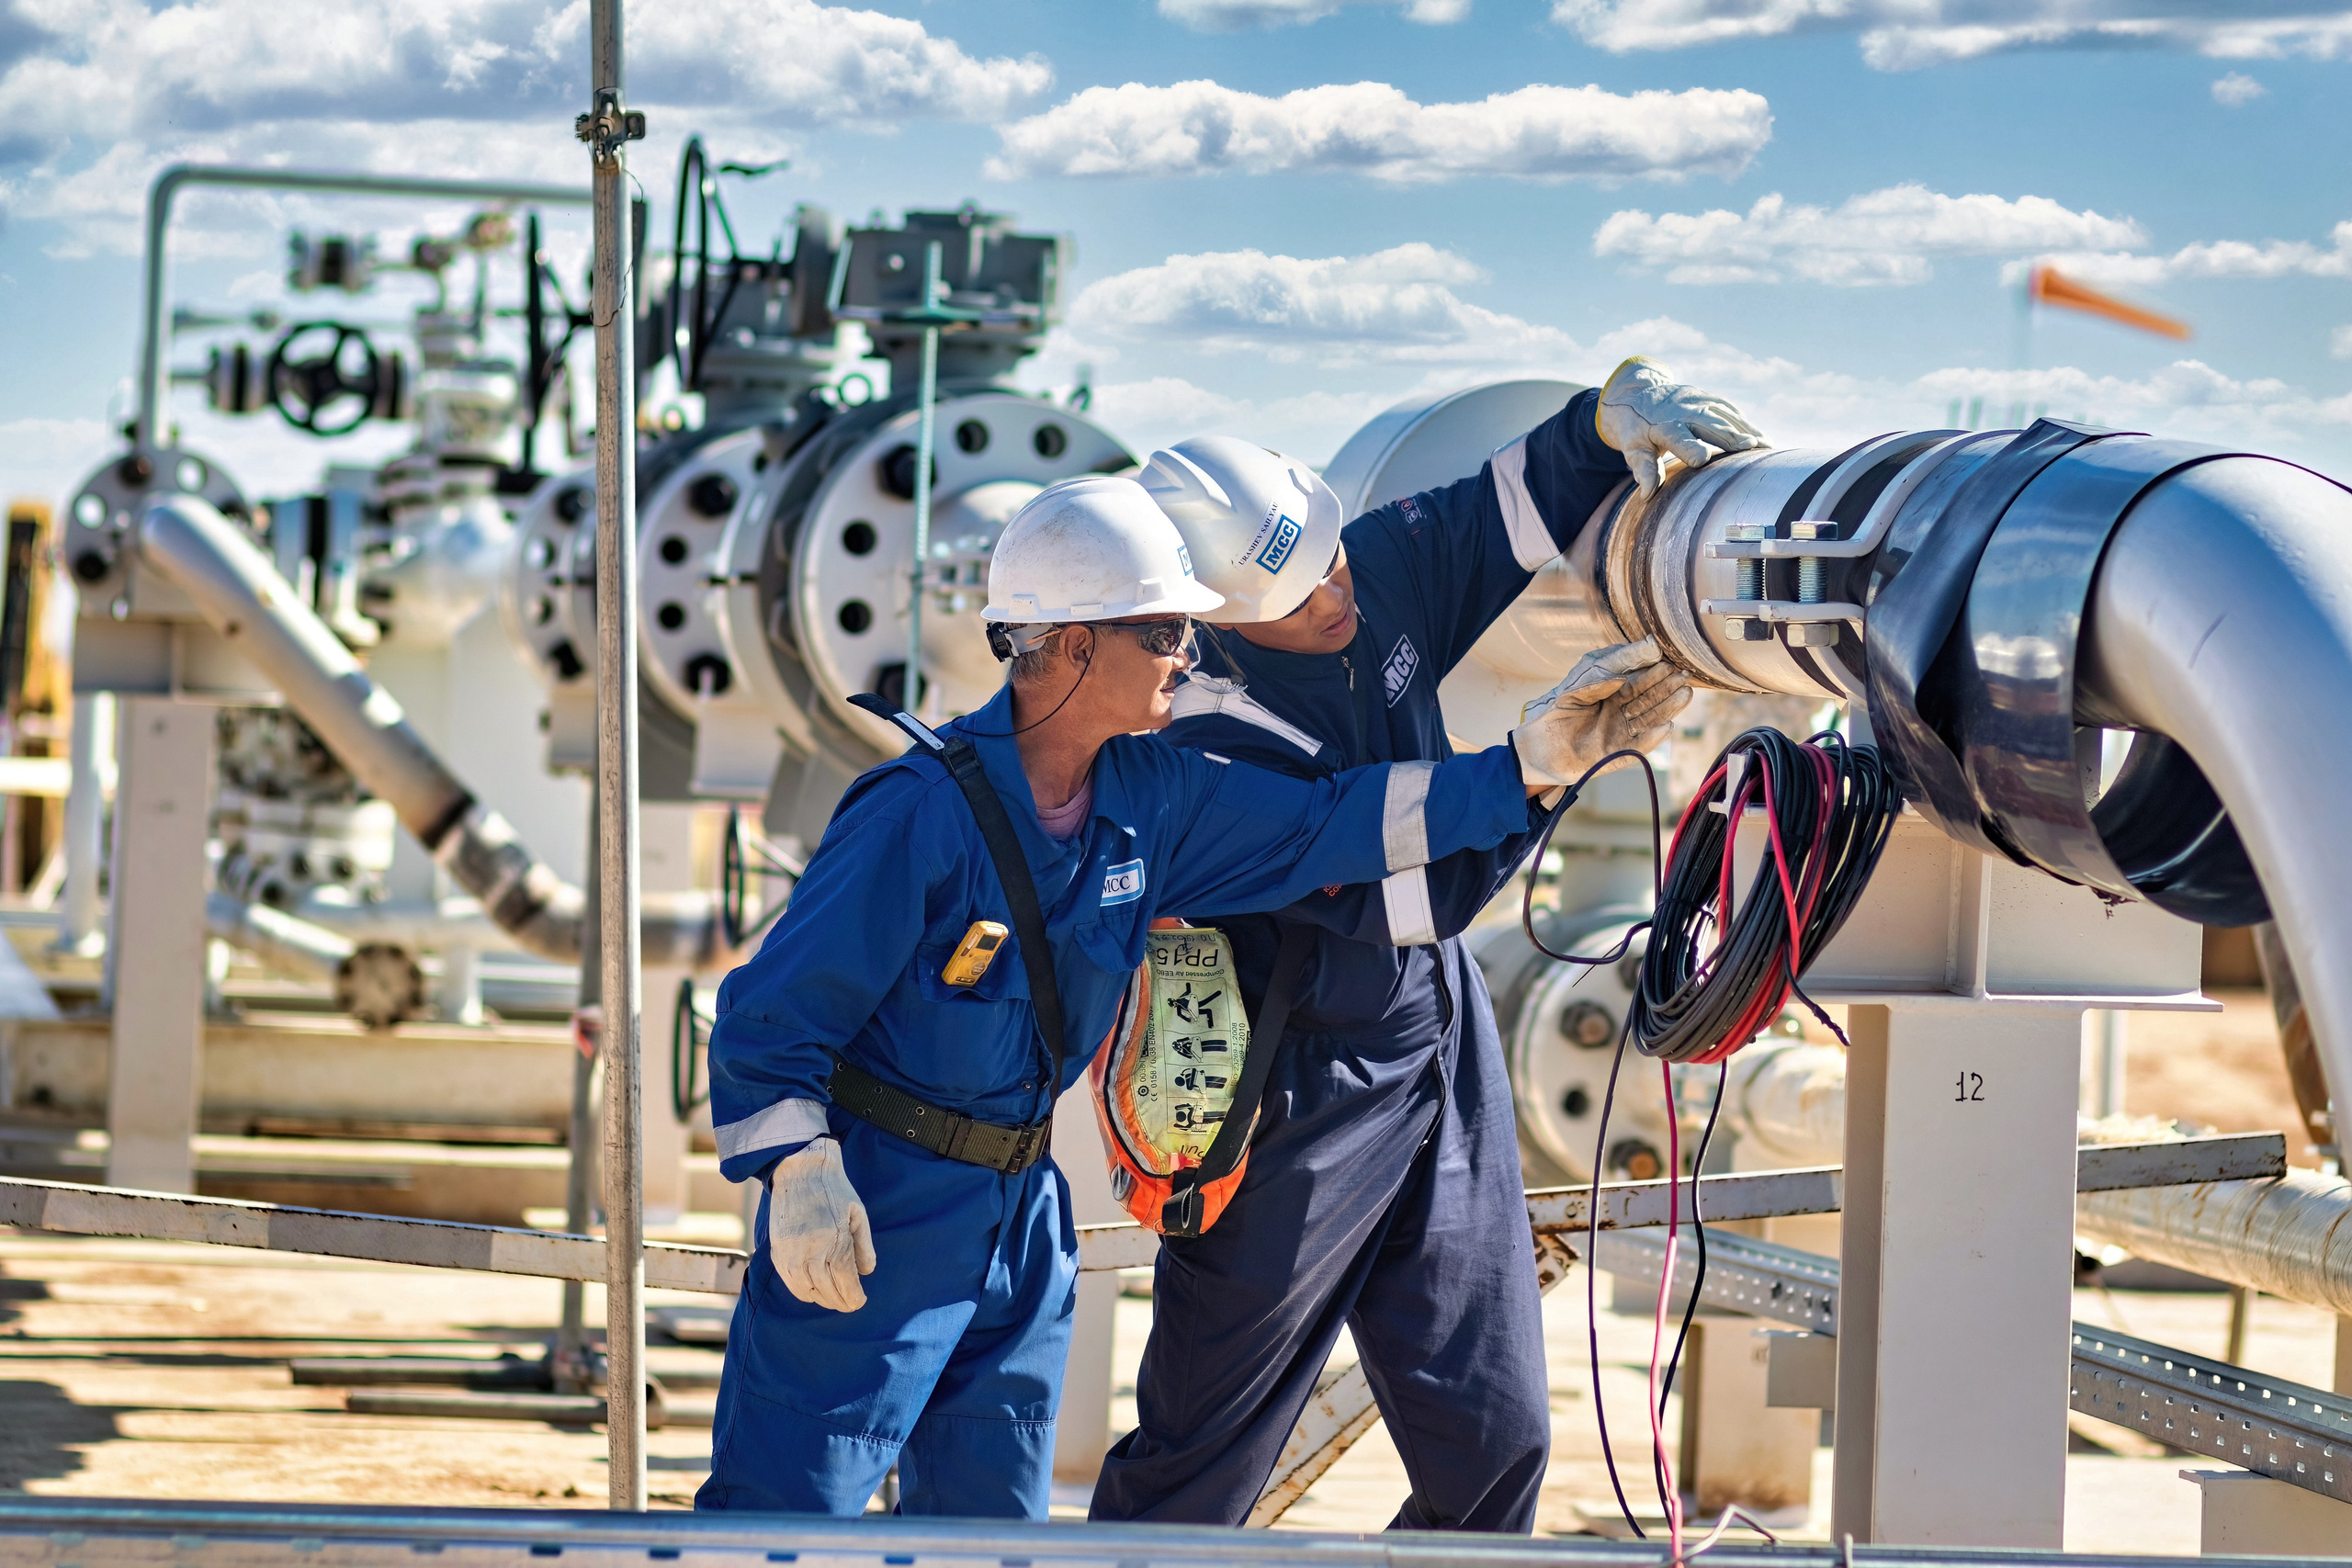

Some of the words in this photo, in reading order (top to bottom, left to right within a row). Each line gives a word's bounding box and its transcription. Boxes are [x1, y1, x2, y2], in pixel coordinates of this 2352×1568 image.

[1238, 534, 1262, 566] URASHEV
[1266, 525, 1295, 566] MCC
[1384, 643, 1415, 701] MCC
[1157, 948, 1218, 967] PP15
[1185, 968, 1225, 977] Compressed
[1955, 1071, 1985, 1102] 12
